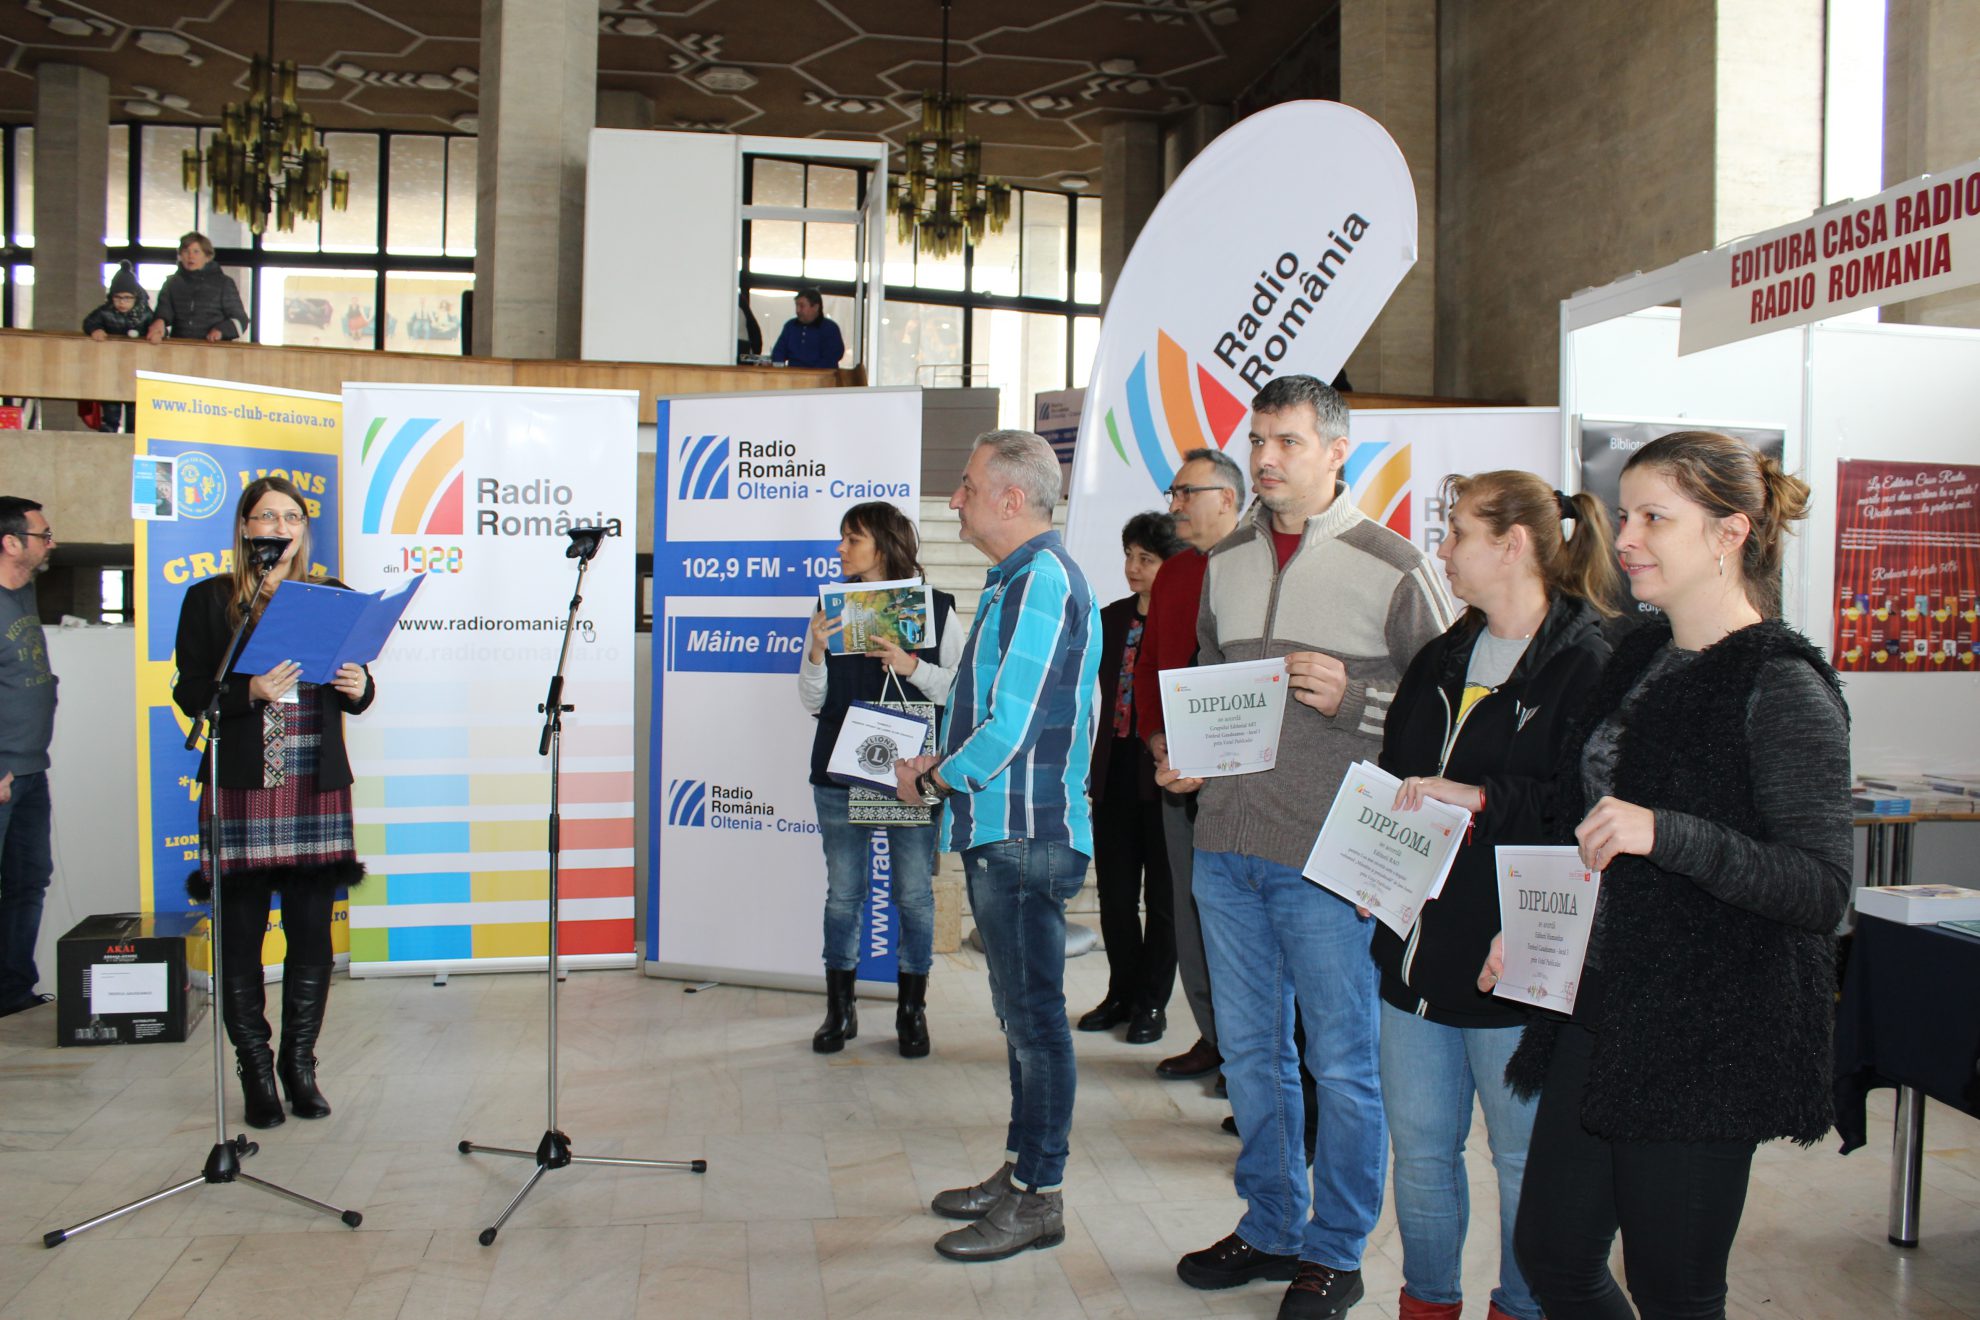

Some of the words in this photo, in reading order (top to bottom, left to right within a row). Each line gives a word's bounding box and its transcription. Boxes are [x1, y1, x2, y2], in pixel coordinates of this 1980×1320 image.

[1731, 227, 1817, 289] EDITURA
[1823, 203, 1887, 259] CASA
[1894, 172, 1980, 237] RADIO
[1750, 272, 1816, 325] RADIO
[1828, 232, 1952, 303] ROMANIA
[1213, 251, 1300, 370] Radio
[1239, 212, 1371, 392] România
[152, 397, 336, 429] www.lions-club-craiova.ro
[739, 440, 796, 458] Radio
[738, 460, 826, 479] România
[477, 478, 573, 505] Radio
[737, 482, 809, 500] Oltenia
[830, 480, 911, 498] Craiova
[383, 564, 400, 574] din
[400, 546, 463, 574] 1928
[682, 557, 740, 582] 102,9
[746, 557, 780, 578] FM
[687, 630, 760, 653] Mâine
[766, 630, 804, 653] înc
[1188, 692, 1267, 714] DIPLOMA
[869, 736, 895, 750] LIONS
[871, 747, 883, 763] L
[712, 785, 753, 800] Radio
[711, 800, 775, 816] România
[711, 815, 762, 831] Oltenia
[776, 818, 822, 834] Craiov
[1358, 806, 1432, 858] DIPLOMA
[165, 834, 199, 848] LION
[1519, 889, 1578, 916] DIPLOMA
[107, 945, 135, 953] AKAI
